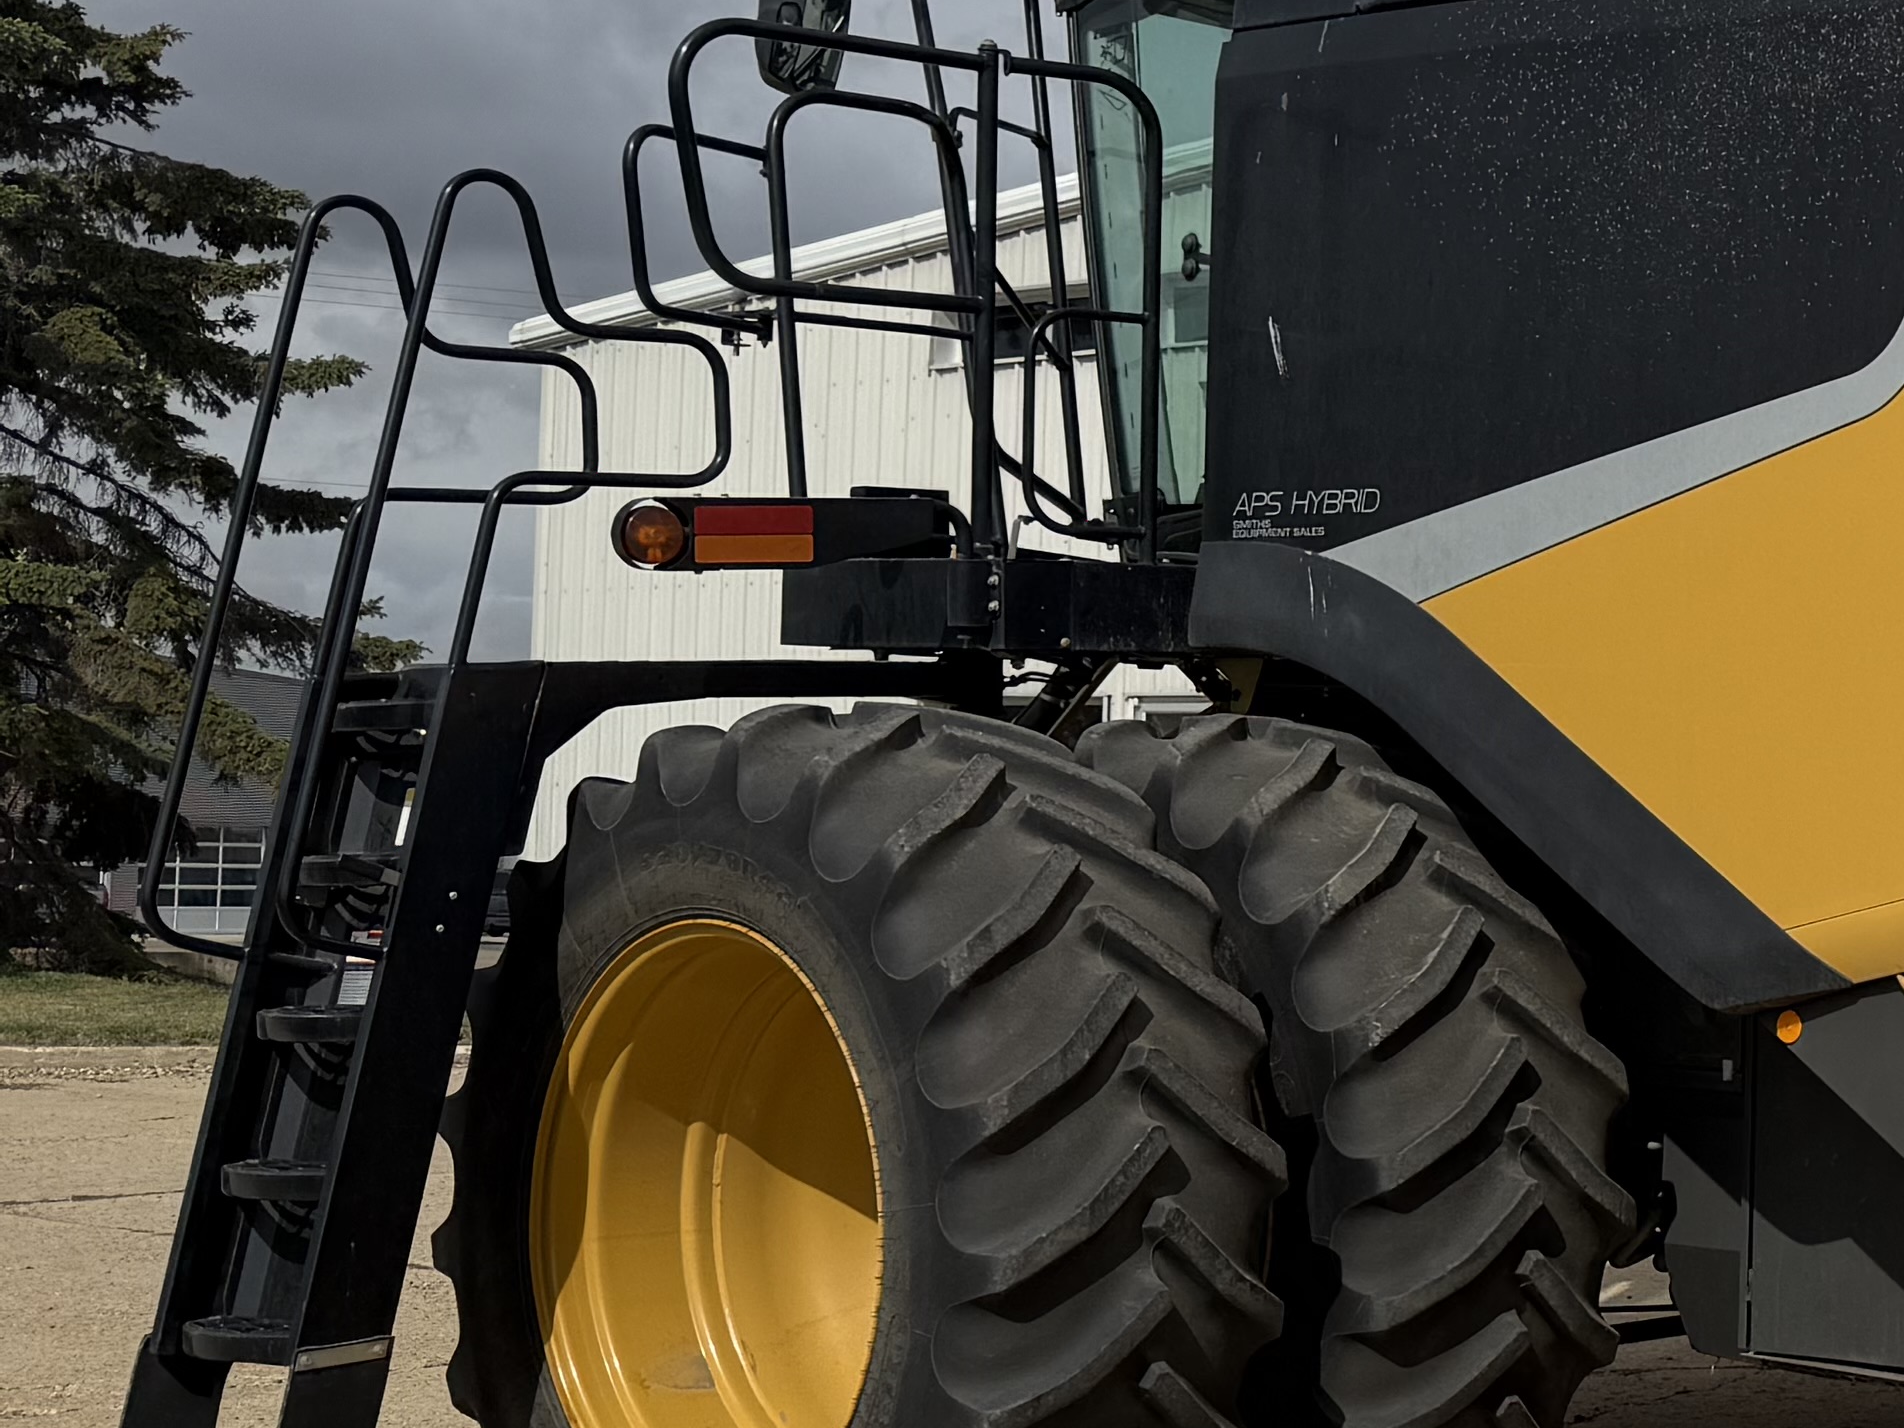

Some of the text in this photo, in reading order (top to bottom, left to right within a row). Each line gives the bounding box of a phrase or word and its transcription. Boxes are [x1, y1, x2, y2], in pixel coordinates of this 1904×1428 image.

[1232, 488, 1381, 516] APS HYBRID
[1232, 526, 1325, 539] EQUIPMENT SALES
